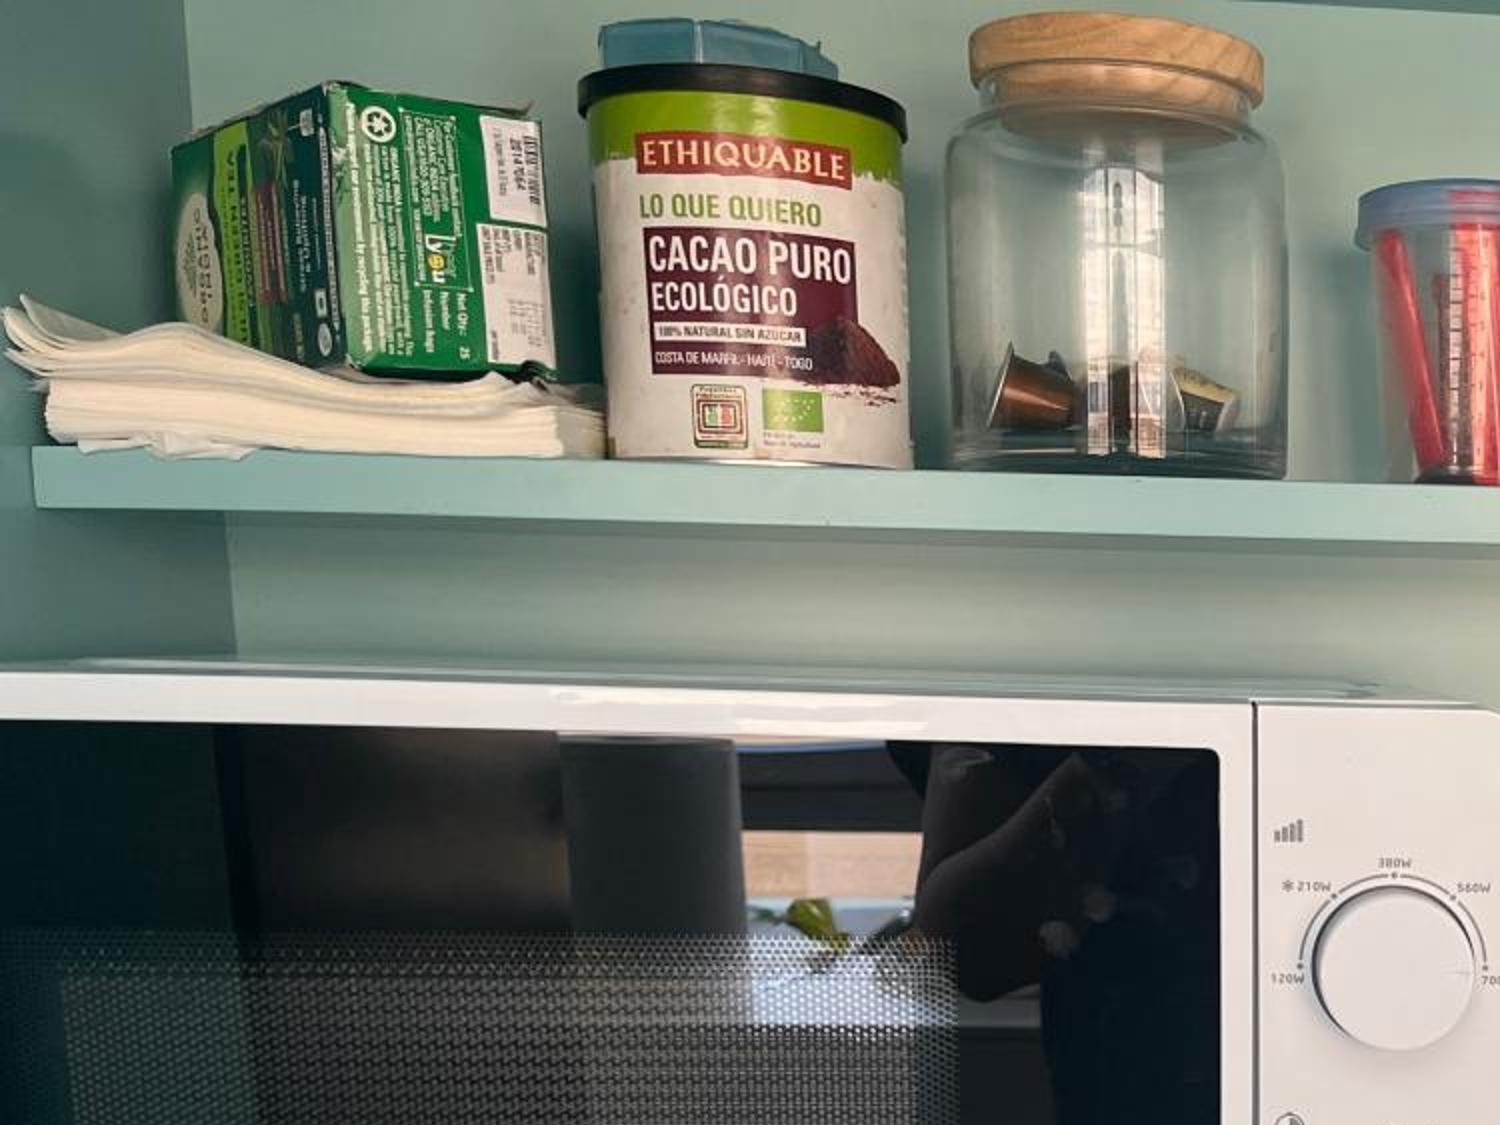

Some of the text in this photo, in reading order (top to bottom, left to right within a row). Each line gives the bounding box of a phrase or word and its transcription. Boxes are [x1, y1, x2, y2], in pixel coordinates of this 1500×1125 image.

[642, 140, 846, 180] ETHIQUABLE
[640, 193, 821, 227] LO QUE QUIERO
[649, 235, 851, 284] CACAO PURO
[652, 275, 797, 317] ECOLÓGICO
[683, 326, 733, 339] NATURAL
[735, 328, 755, 340] SIN
[655, 351, 685, 364] COSTA
[686, 352, 699, 364] DE
[783, 355, 813, 370] TOGO
[1297, 881, 1331, 892] 210W
[1271, 973, 1305, 984] 120W
